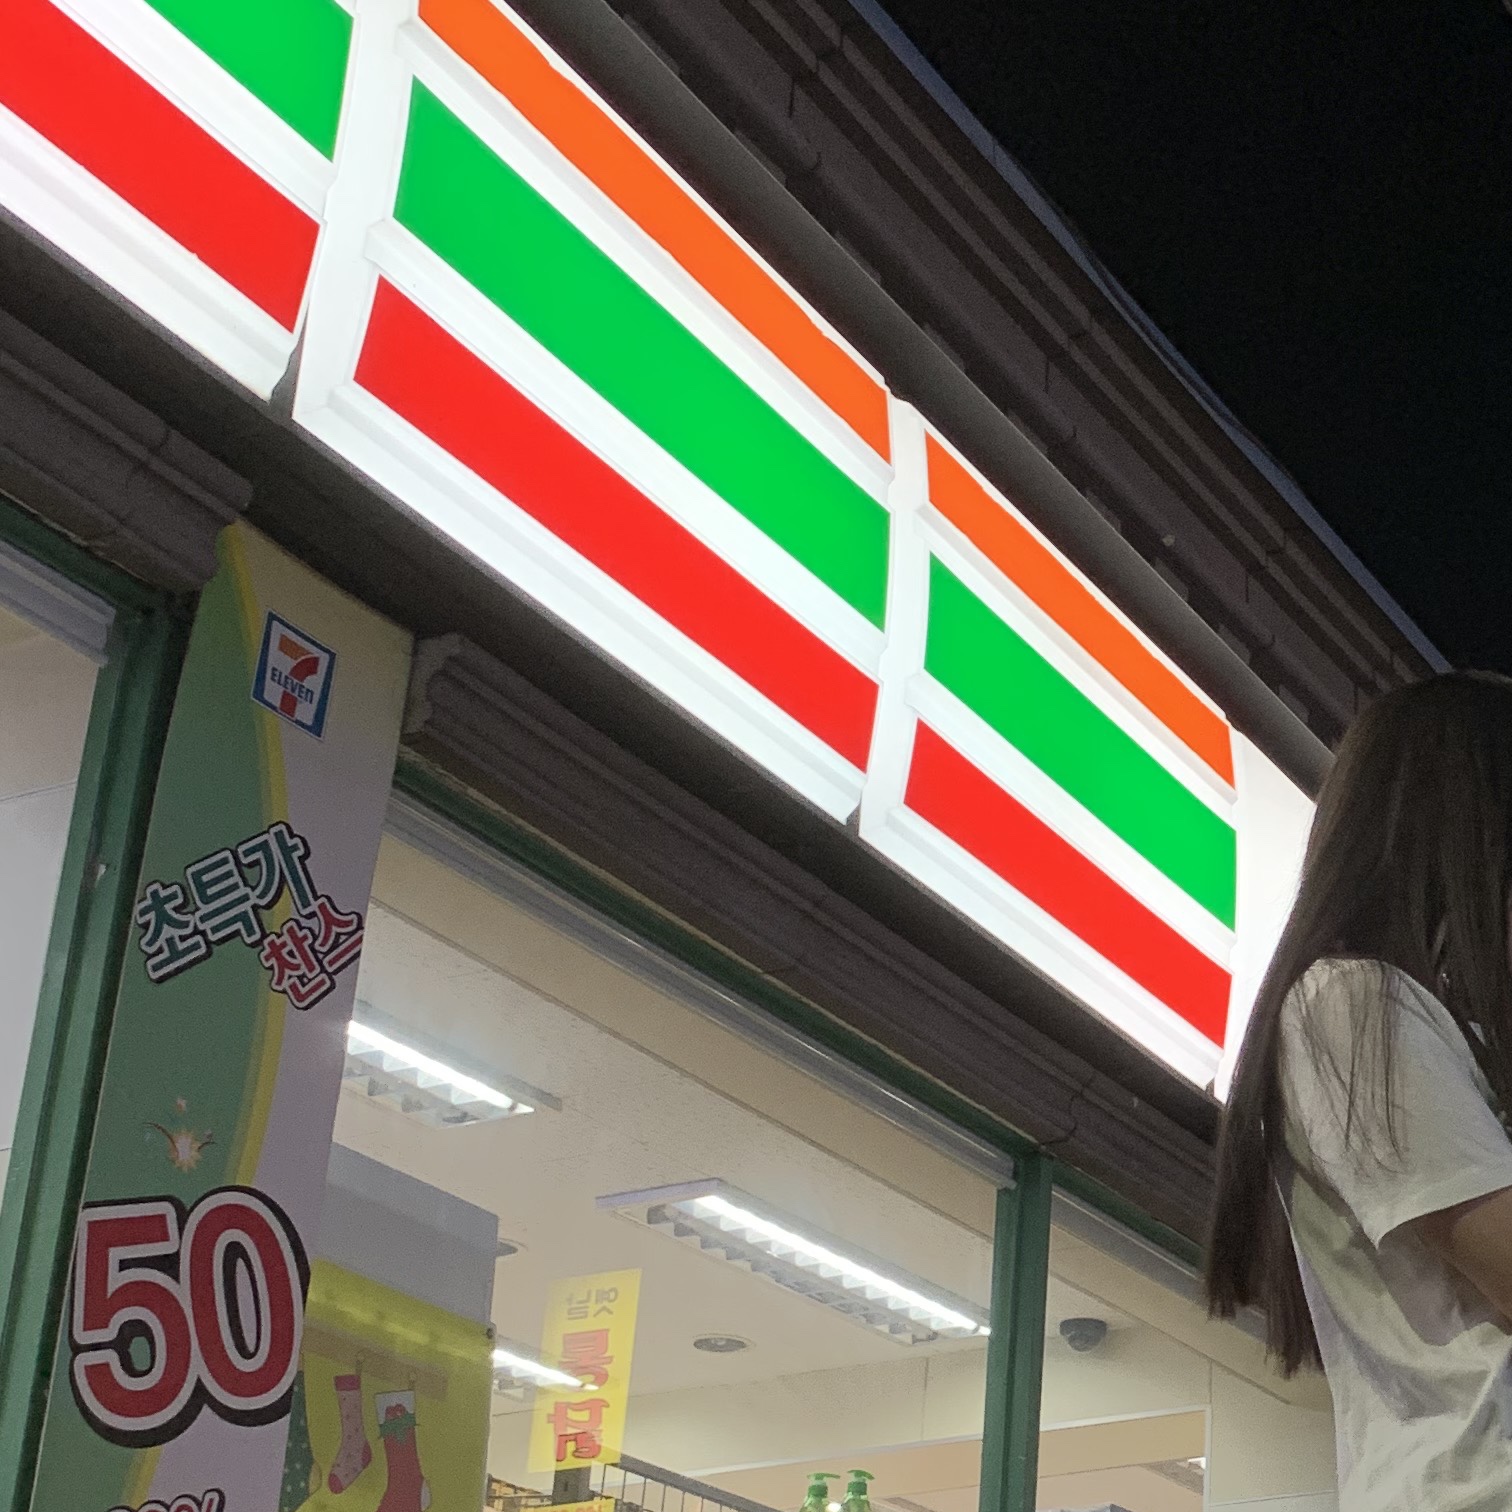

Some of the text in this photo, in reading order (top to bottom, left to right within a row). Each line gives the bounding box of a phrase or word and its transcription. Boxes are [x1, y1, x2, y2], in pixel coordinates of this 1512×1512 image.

[137, 821, 312, 984] 초특가
[259, 895, 363, 1010] 찬스
[70, 1185, 310, 1449] 50
